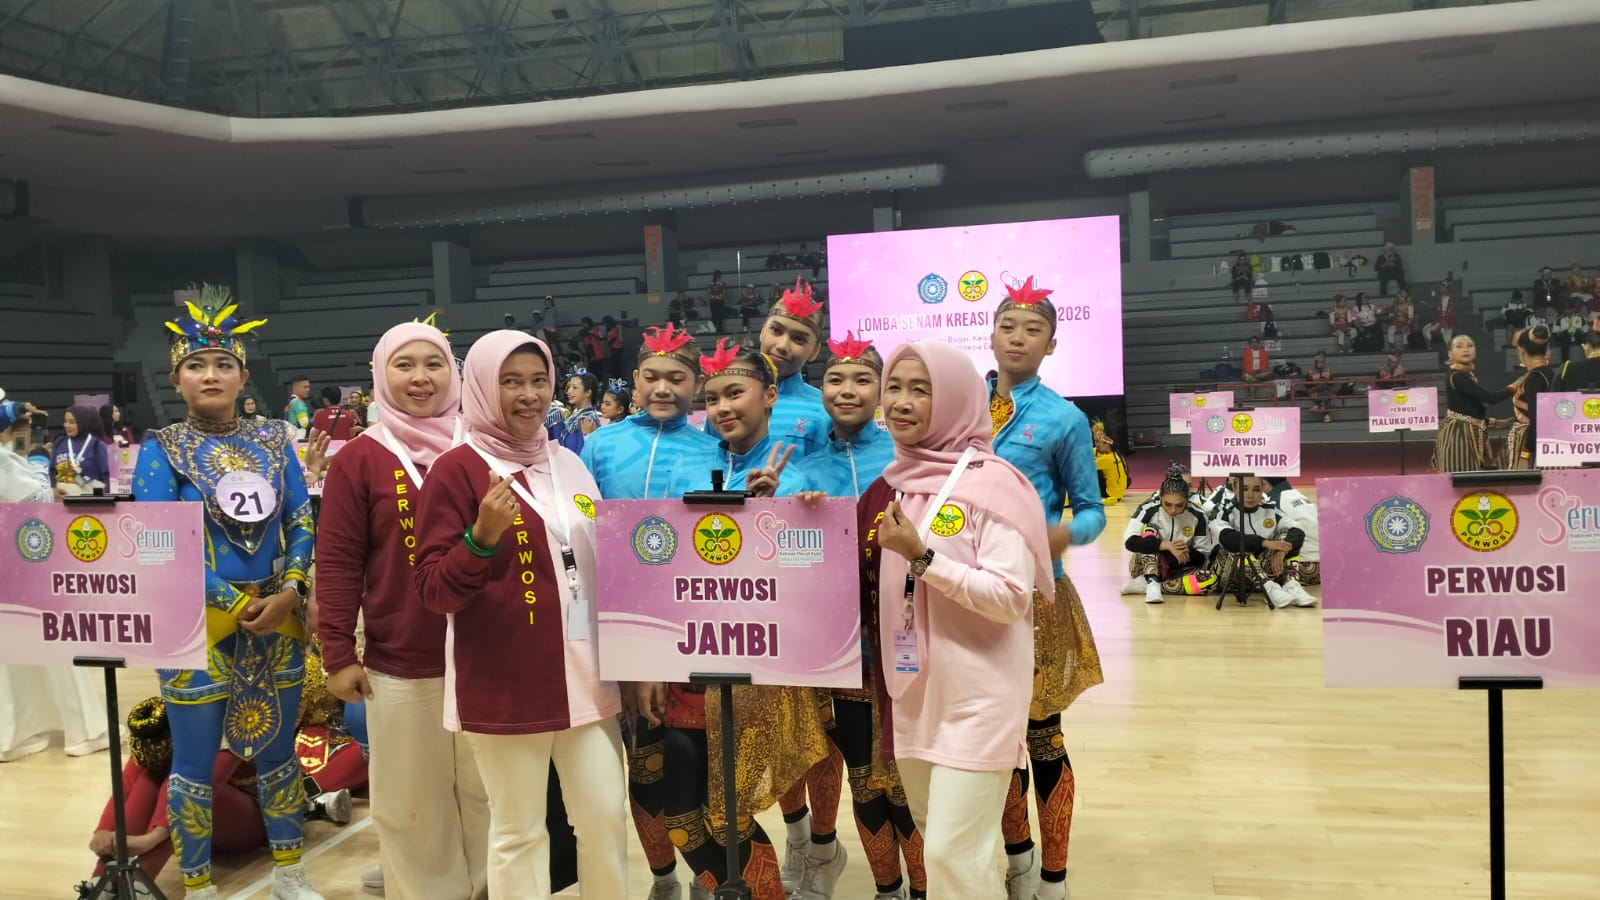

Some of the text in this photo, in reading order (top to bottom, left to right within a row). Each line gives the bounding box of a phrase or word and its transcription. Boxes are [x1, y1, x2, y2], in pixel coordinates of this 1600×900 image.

[859, 318, 897, 332] LOMBA
[902, 315, 942, 330] SENAM
[946, 311, 989, 327] KREASI
[1058, 306, 1090, 321] 2026
[1372, 416, 1436, 426] MALUKU UTARA
[1224, 438, 1266, 446] PERWOSI
[1542, 443, 1564, 454] D.I.
[1203, 454, 1288, 467] JAWA TIMUR
[230, 491, 264, 516] 21
[393, 469, 416, 566] PERWOS
[118, 514, 174, 559] Seruni
[755, 511, 823, 561] Seruni
[1460, 530, 1510, 548] PERWOSI
[513, 513, 537, 625] ERWOSI
[1427, 565, 1566, 594] PERWOSI
[53, 573, 136, 594] PERWOSI
[676, 577, 777, 601] PERWOSI
[42, 612, 152, 643] BANTEN
[677, 621, 779, 657] JAMBI
[1445, 617, 1551, 657] RIAU
